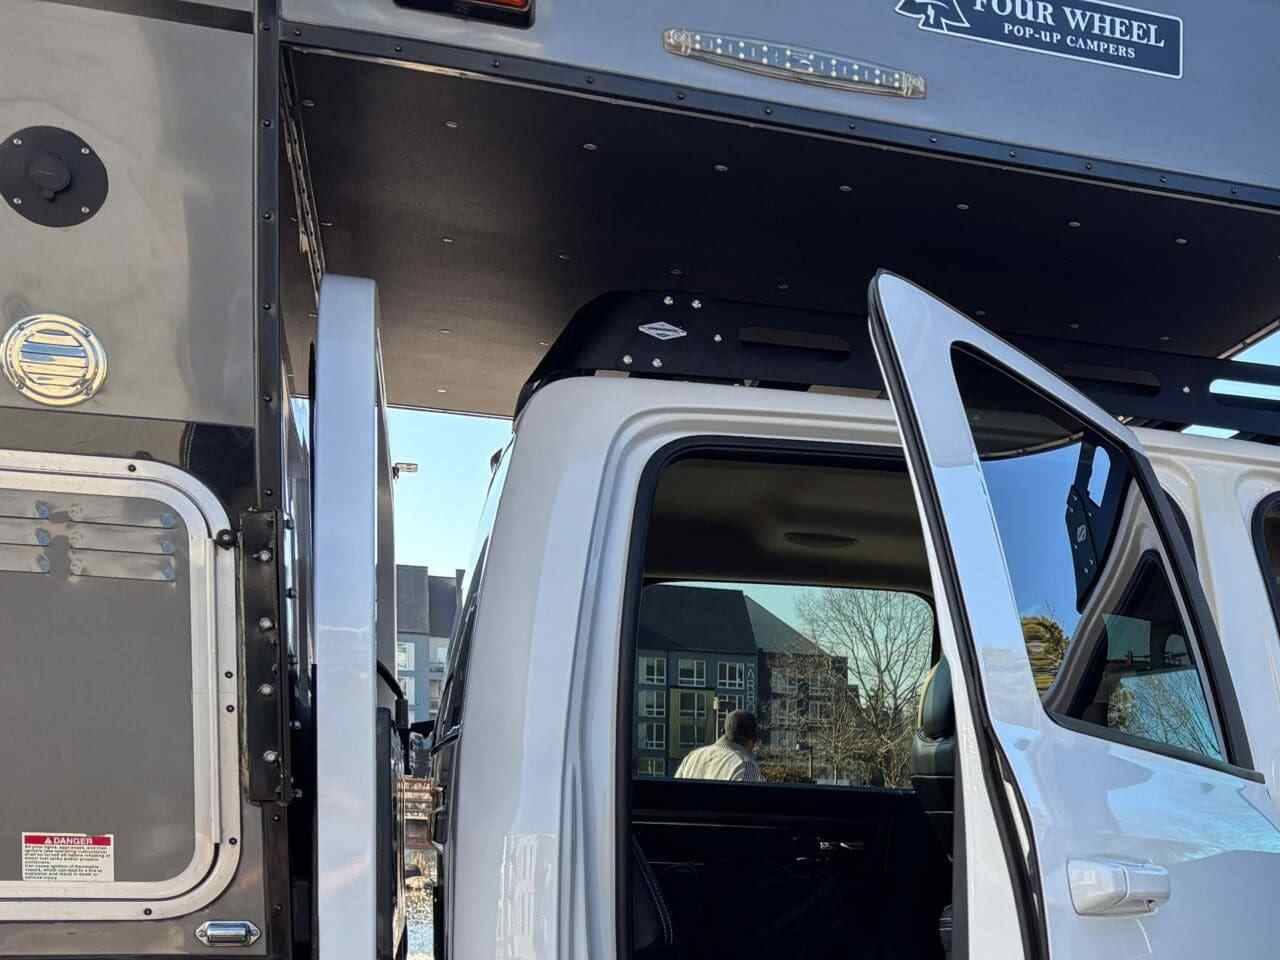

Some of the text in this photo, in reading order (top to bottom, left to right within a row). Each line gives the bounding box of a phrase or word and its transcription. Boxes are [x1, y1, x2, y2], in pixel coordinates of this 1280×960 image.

[1003, 22, 1136, 58] POP-UP CAMPERS
[1061, 6, 1165, 47] WHEEL
[53, 837, 93, 845] DANGER
